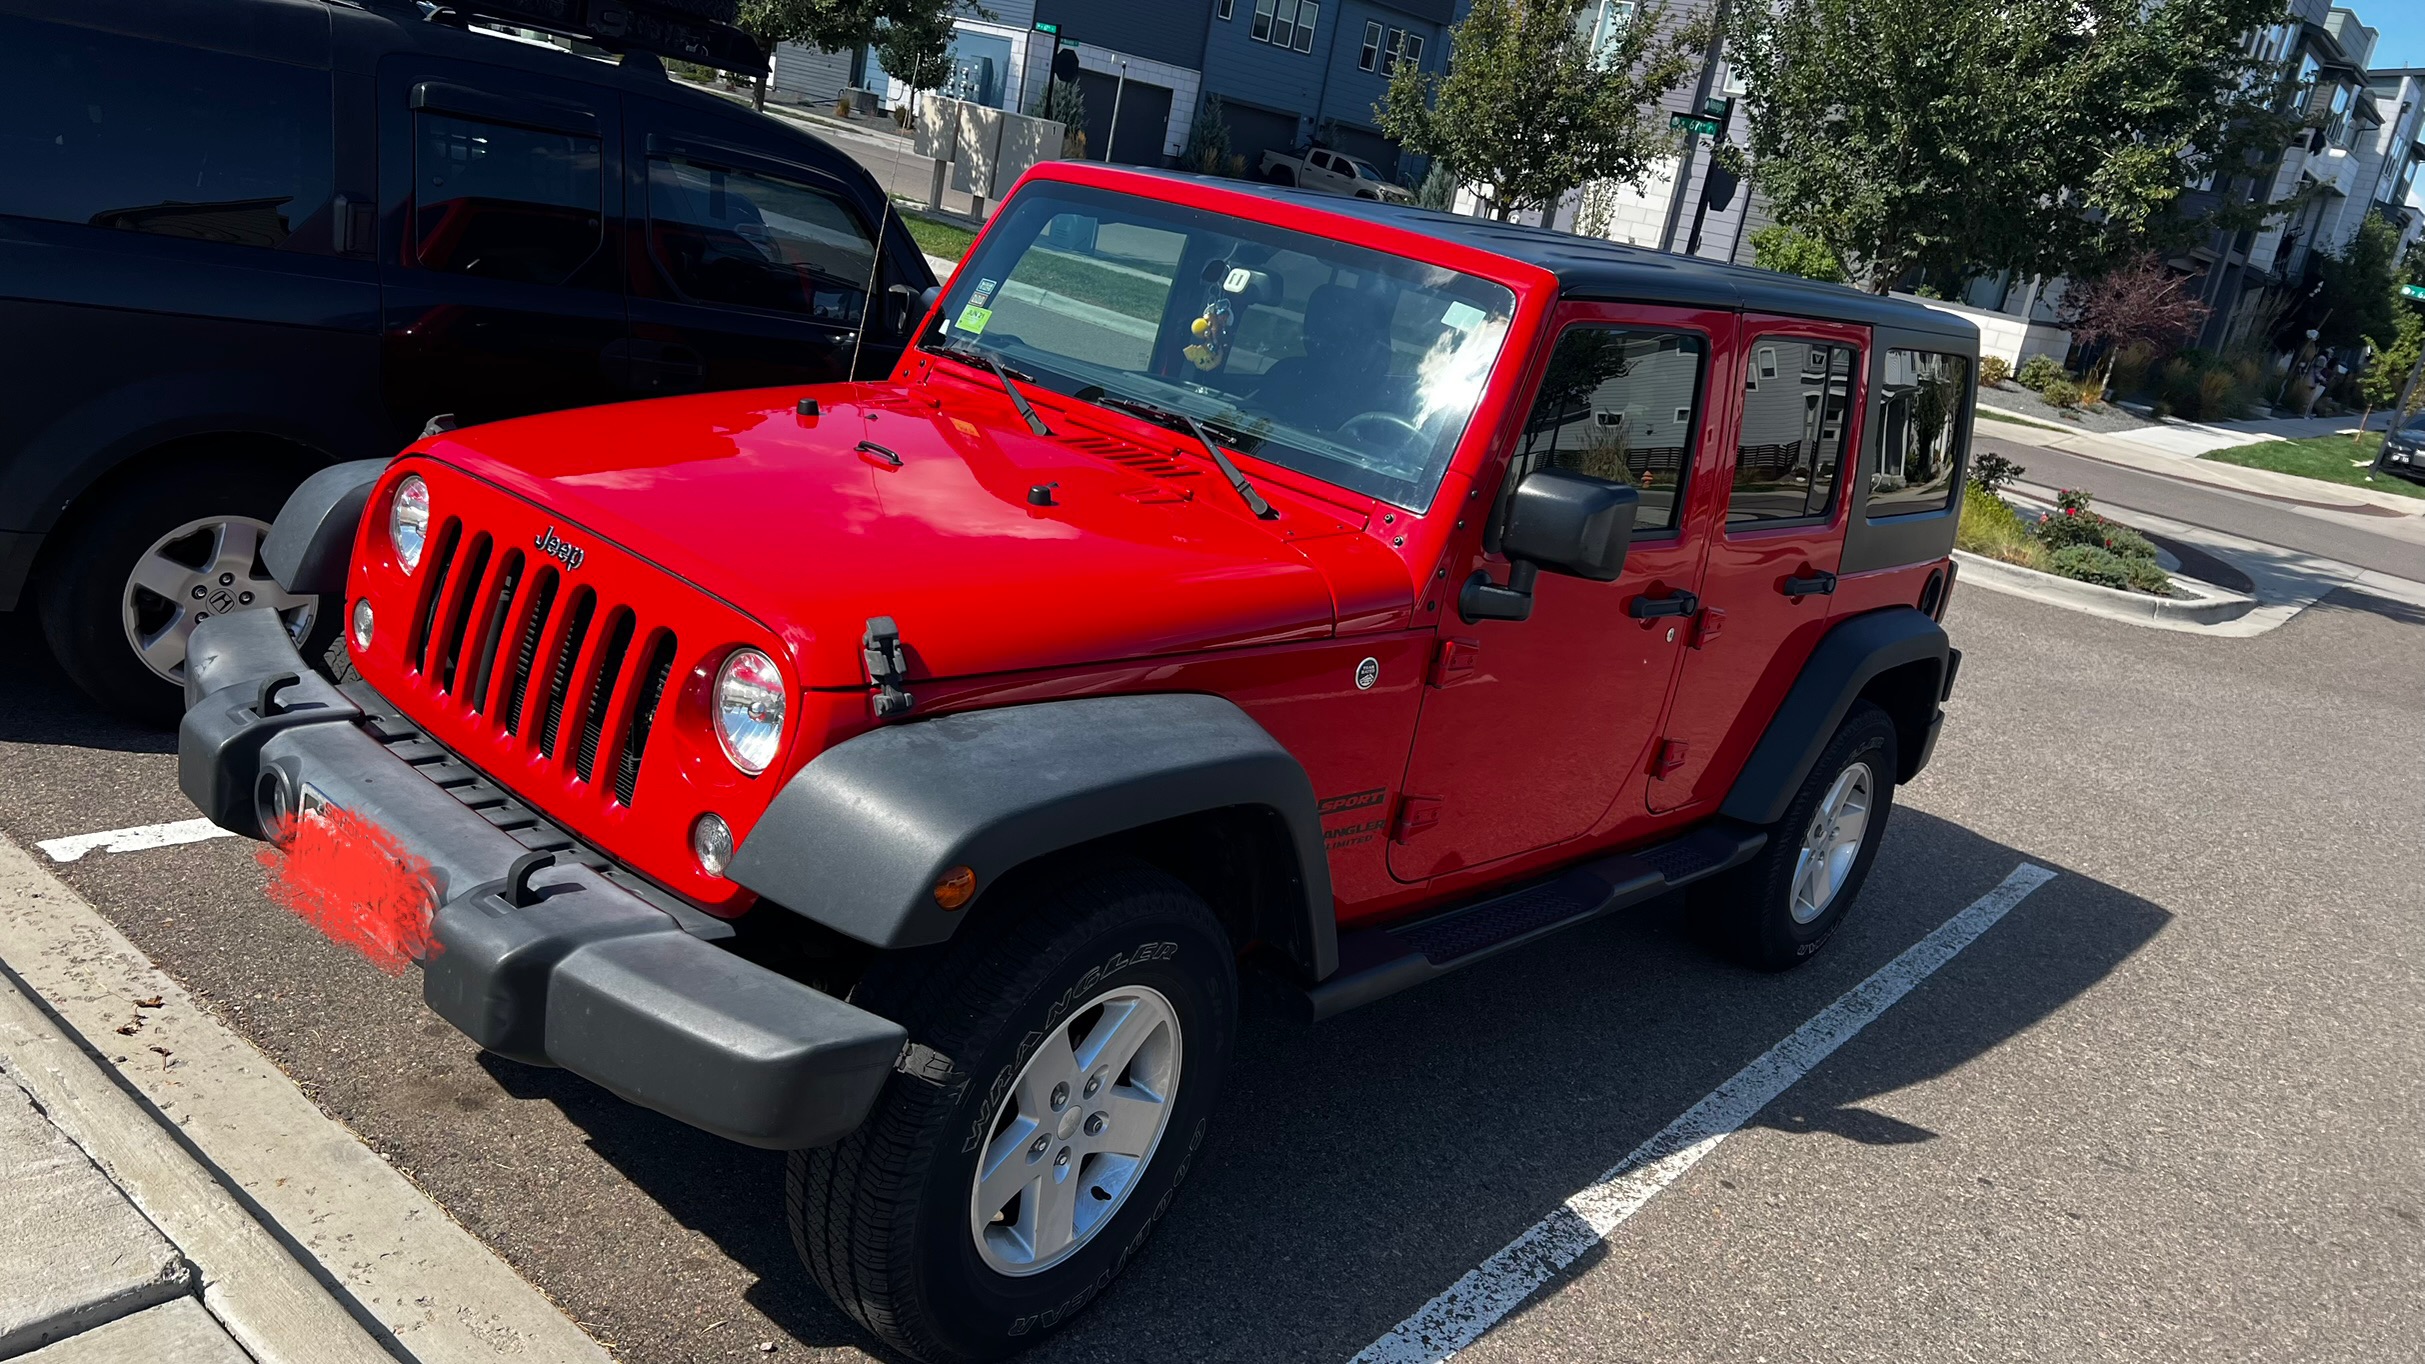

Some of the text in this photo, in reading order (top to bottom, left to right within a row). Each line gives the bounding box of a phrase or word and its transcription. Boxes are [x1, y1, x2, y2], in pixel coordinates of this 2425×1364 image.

[535, 525, 584, 571] Jeep
[1319, 791, 1385, 812] SPORT
[1324, 819, 1386, 838] ANGLER
[1325, 835, 1373, 850] LIMITED
[961, 941, 1179, 1154] WRANGLER
[1007, 1118, 1208, 1337] GOODYEAR
